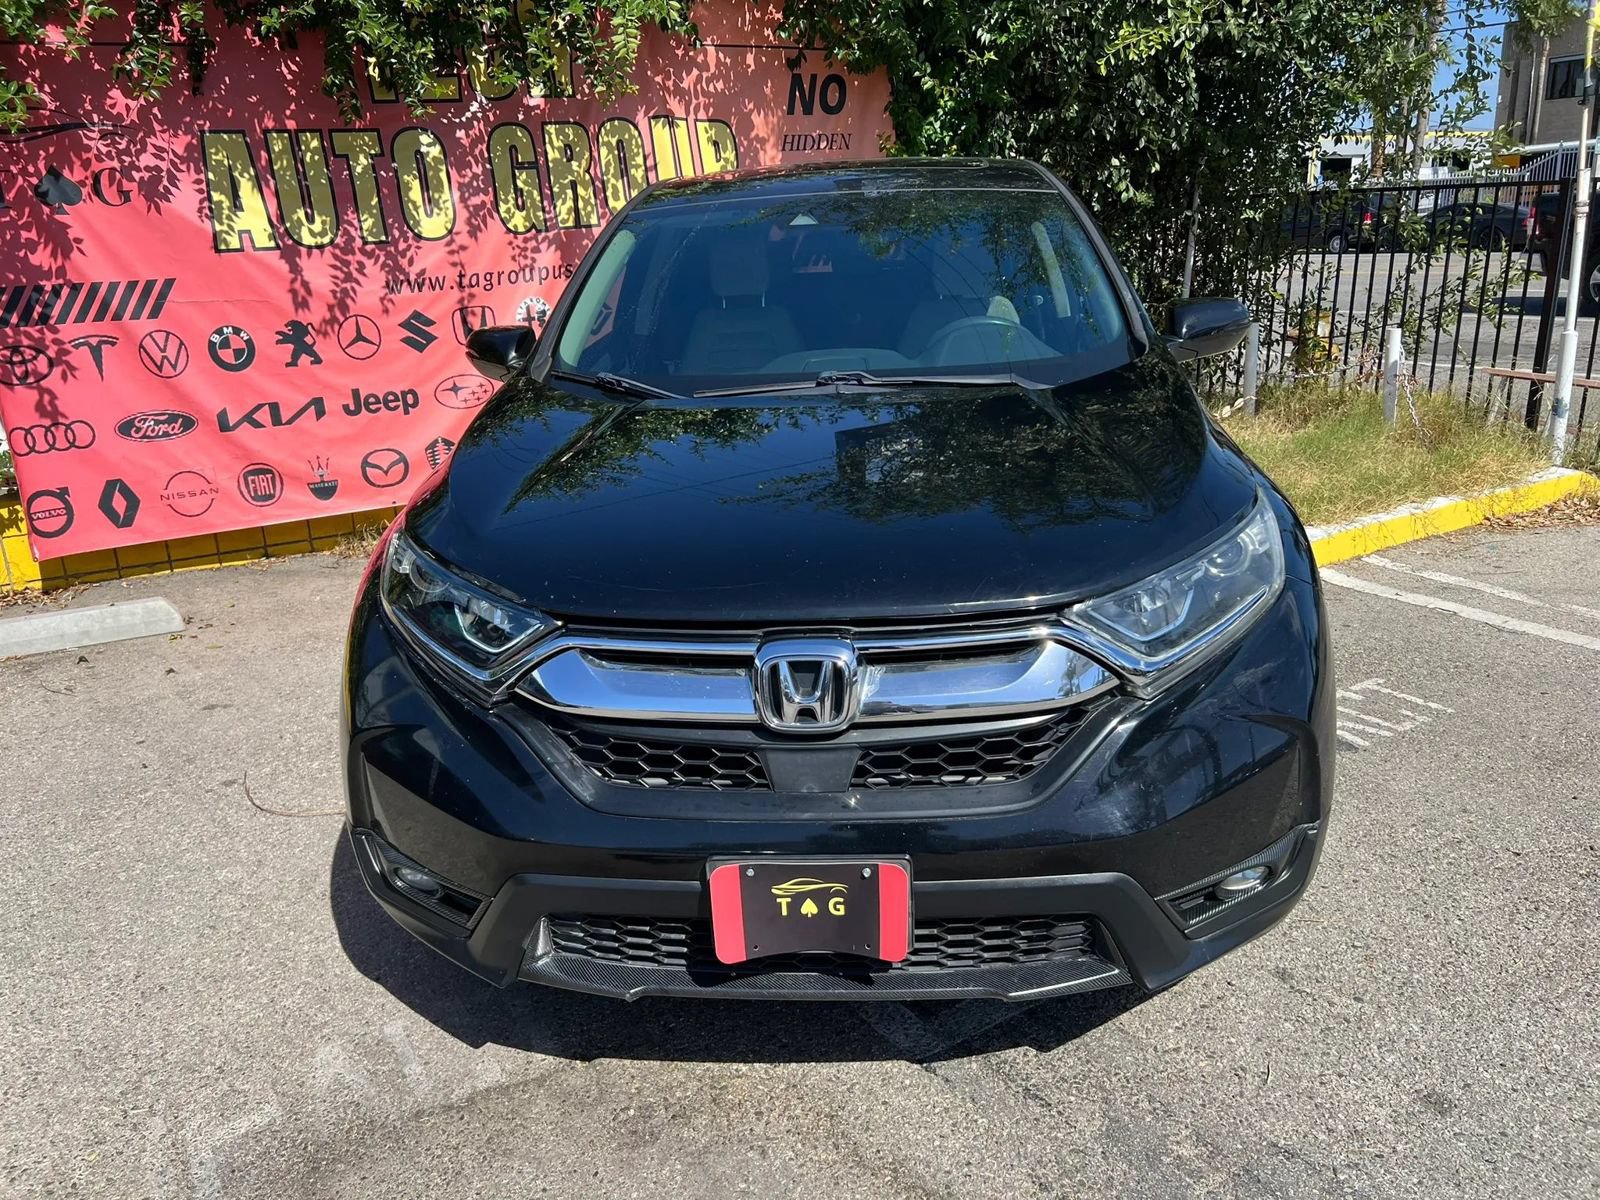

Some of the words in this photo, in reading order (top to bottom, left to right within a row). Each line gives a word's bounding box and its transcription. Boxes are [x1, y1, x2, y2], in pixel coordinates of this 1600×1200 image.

[787, 73, 847, 115] NO
[781, 132, 852, 152] HIDDEN
[202, 126, 456, 254] AUTO
[210, 326, 250, 343] BMW
[342, 387, 420, 417] Jeep
[130, 414, 185, 439] Ford
[160, 487, 220, 502] NISSAN
[248, 473, 273, 496] FIAT
[30, 507, 67, 521] VOLVO
